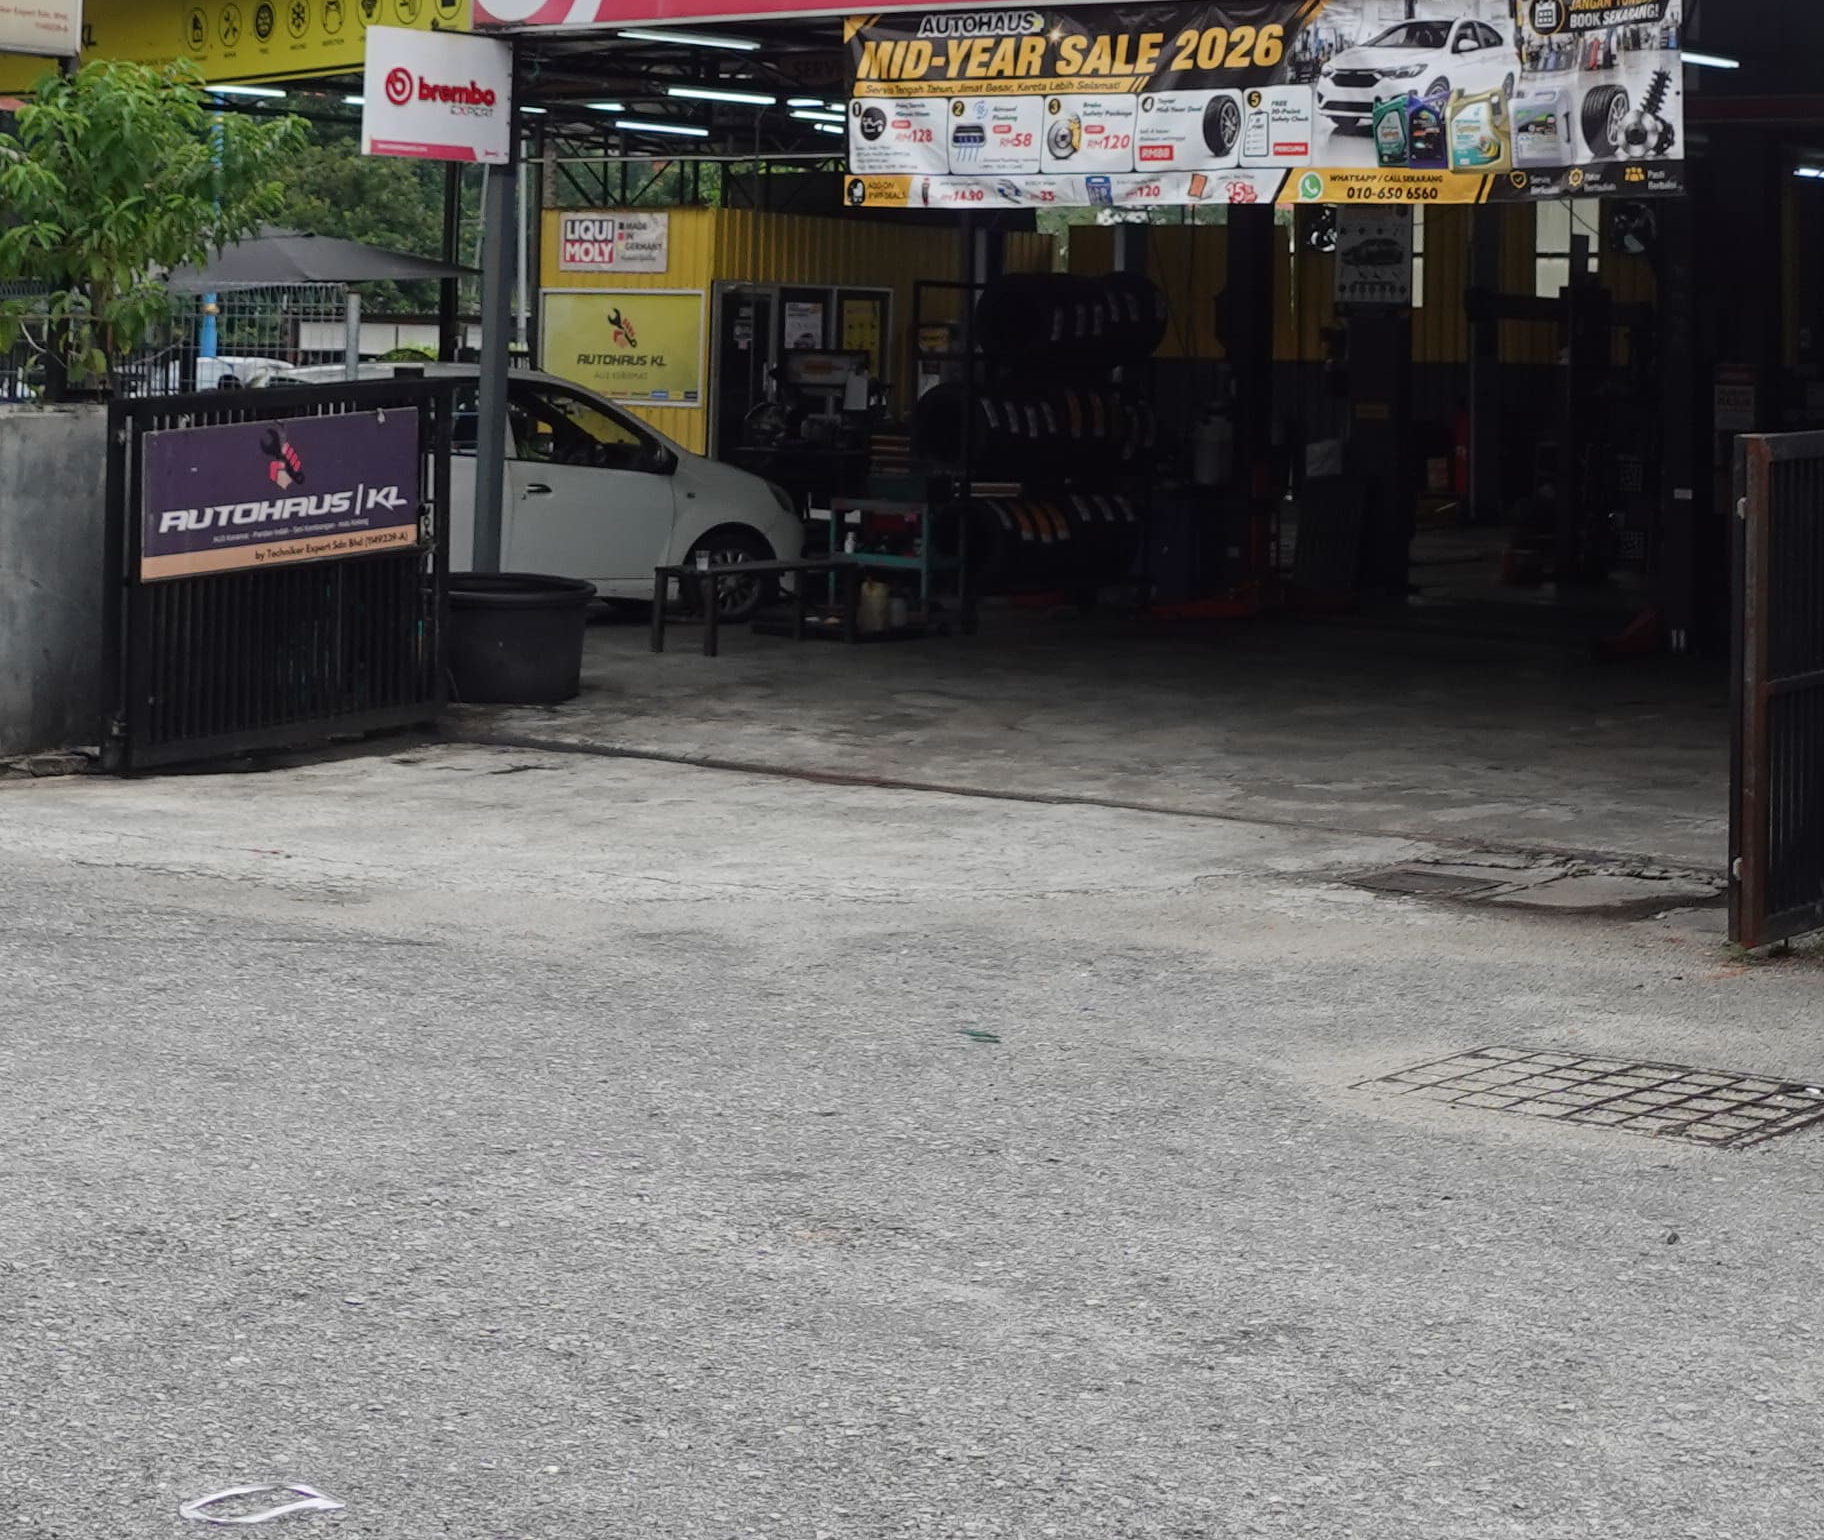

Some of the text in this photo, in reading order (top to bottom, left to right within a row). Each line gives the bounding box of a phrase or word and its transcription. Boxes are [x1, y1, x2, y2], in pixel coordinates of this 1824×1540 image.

[919, 12, 1036, 36] AUTOHAUS
[1570, 13, 1600, 29] BOOK
[856, 25, 1283, 80] MID-YEAR SALE 2026
[418, 76, 496, 106] brembo
[450, 106, 493, 117] EXPERT
[1086, 134, 1130, 150] RM120
[1329, 174, 1376, 183] WHATSAPP
[1401, 174, 1443, 183] SEKARANG
[1347, 186, 1438, 200] 010-650 6560
[566, 220, 613, 241] LIQUI
[564, 242, 613, 263] MOLY
[625, 242, 662, 252] GERMANY
[576, 353, 667, 367] AUTOHAUS KL
[159, 485, 408, 533] AUTOHAUS KL
[255, 550, 265, 561] by
[267, 545, 304, 558] Techniker
[306, 542, 331, 555] Expert
[333, 540, 347, 550] Sdn
[348, 538, 363, 548] Bhd
